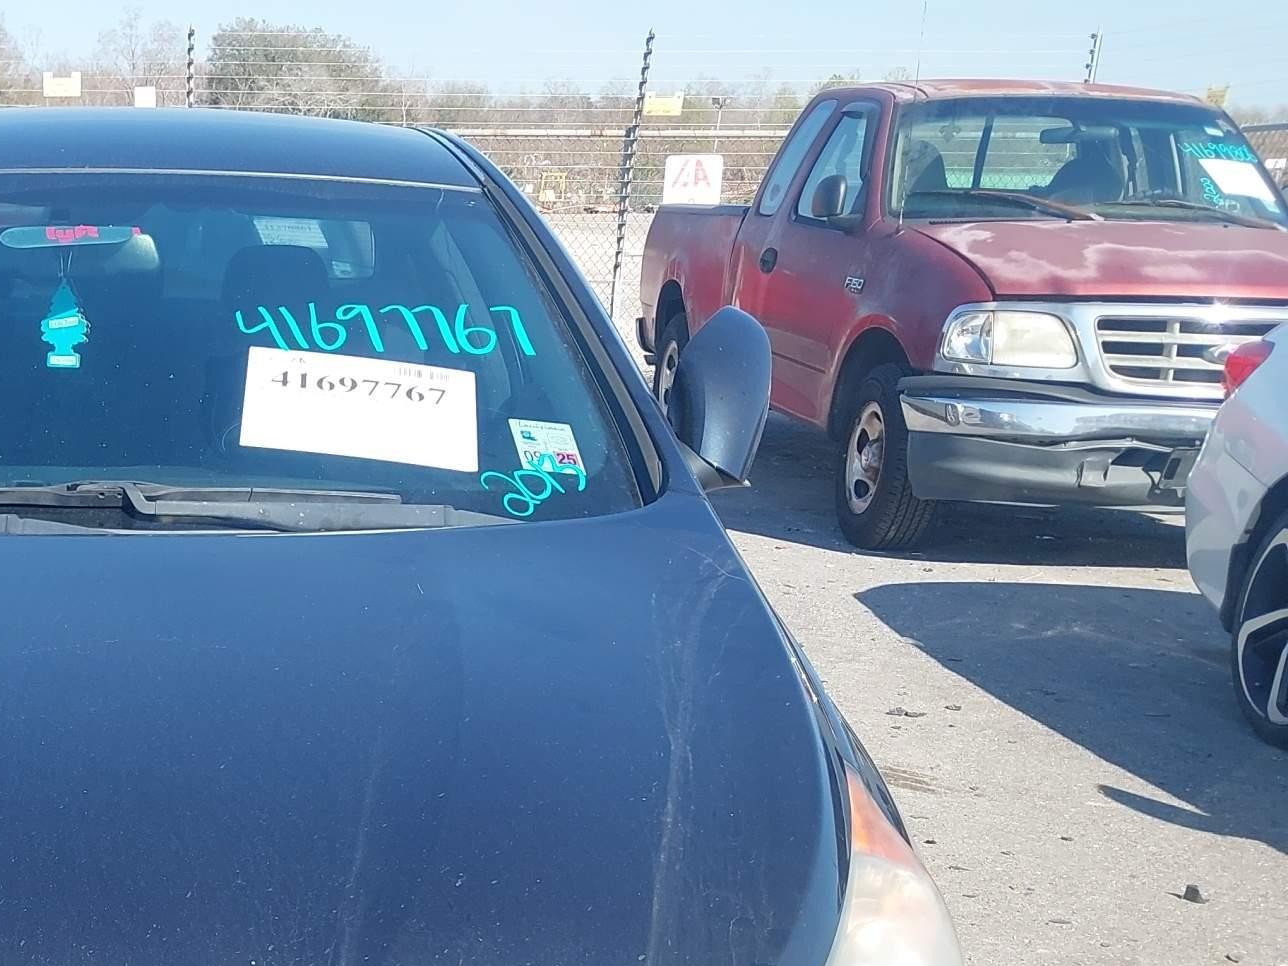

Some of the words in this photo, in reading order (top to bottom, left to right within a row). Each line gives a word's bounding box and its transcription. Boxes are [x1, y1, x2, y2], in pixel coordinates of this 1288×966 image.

[235, 302, 537, 356] 41697767
[271, 370, 447, 405] 41697767
[556, 452, 578, 466] 25
